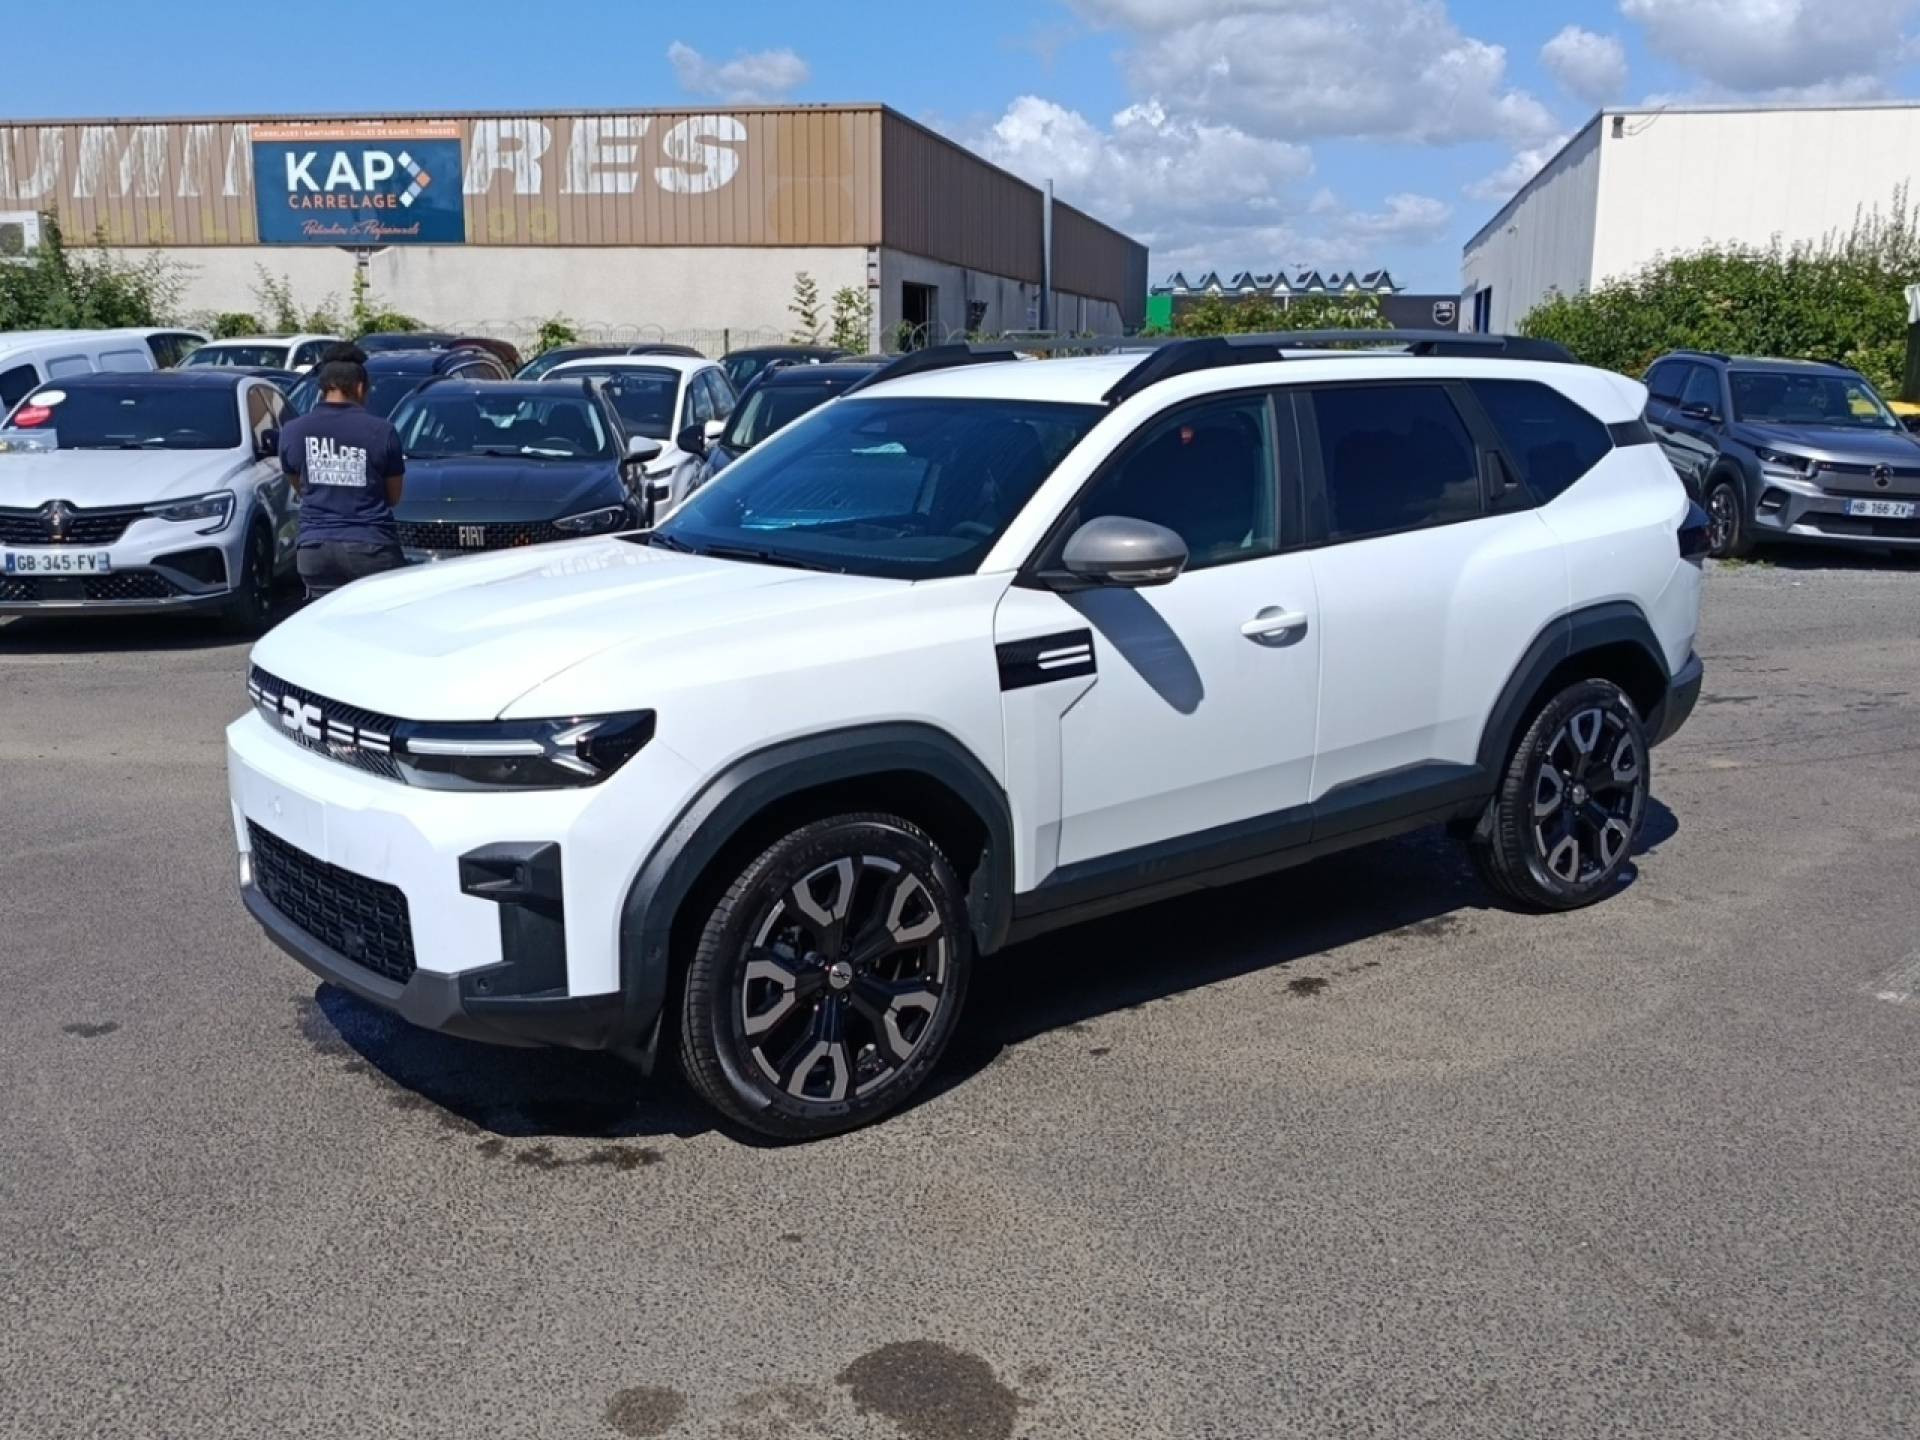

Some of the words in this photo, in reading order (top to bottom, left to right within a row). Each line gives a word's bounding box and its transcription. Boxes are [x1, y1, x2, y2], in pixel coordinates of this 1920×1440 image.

[285, 151, 394, 192] KAP
[288, 194, 397, 209] CARRELAGE
[458, 525, 485, 547] FIAT
